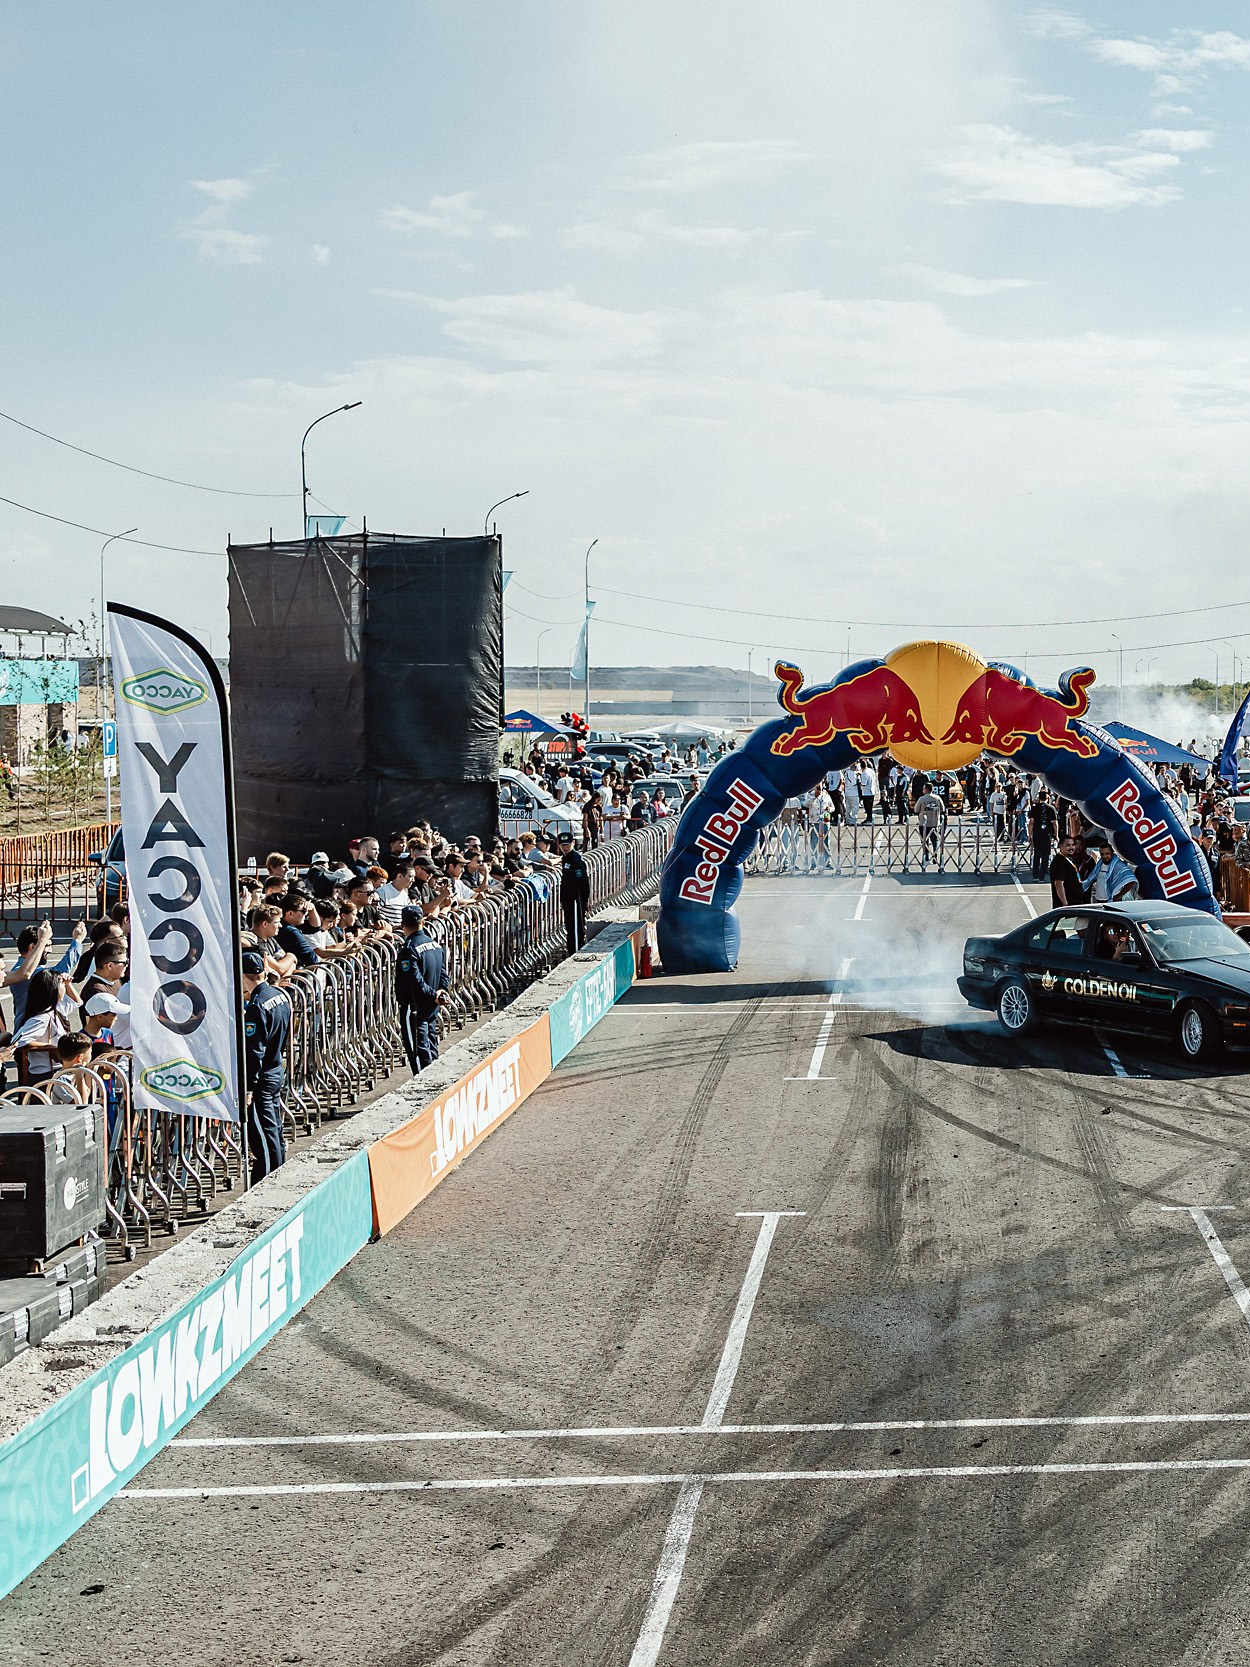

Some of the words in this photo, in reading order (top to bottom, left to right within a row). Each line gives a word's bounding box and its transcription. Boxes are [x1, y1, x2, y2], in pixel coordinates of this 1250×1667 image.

[500, 810, 533, 820] 66666828
[703, 777, 765, 845] Bull
[1106, 778, 1168, 845] Red
[1143, 834, 1198, 899] Bull
[678, 834, 731, 905] Red
[1063, 977, 1118, 999] GOLDEN
[433, 1041, 521, 1174] LOWKZMEET
[86, 1211, 306, 1502] LOWKZMEET
